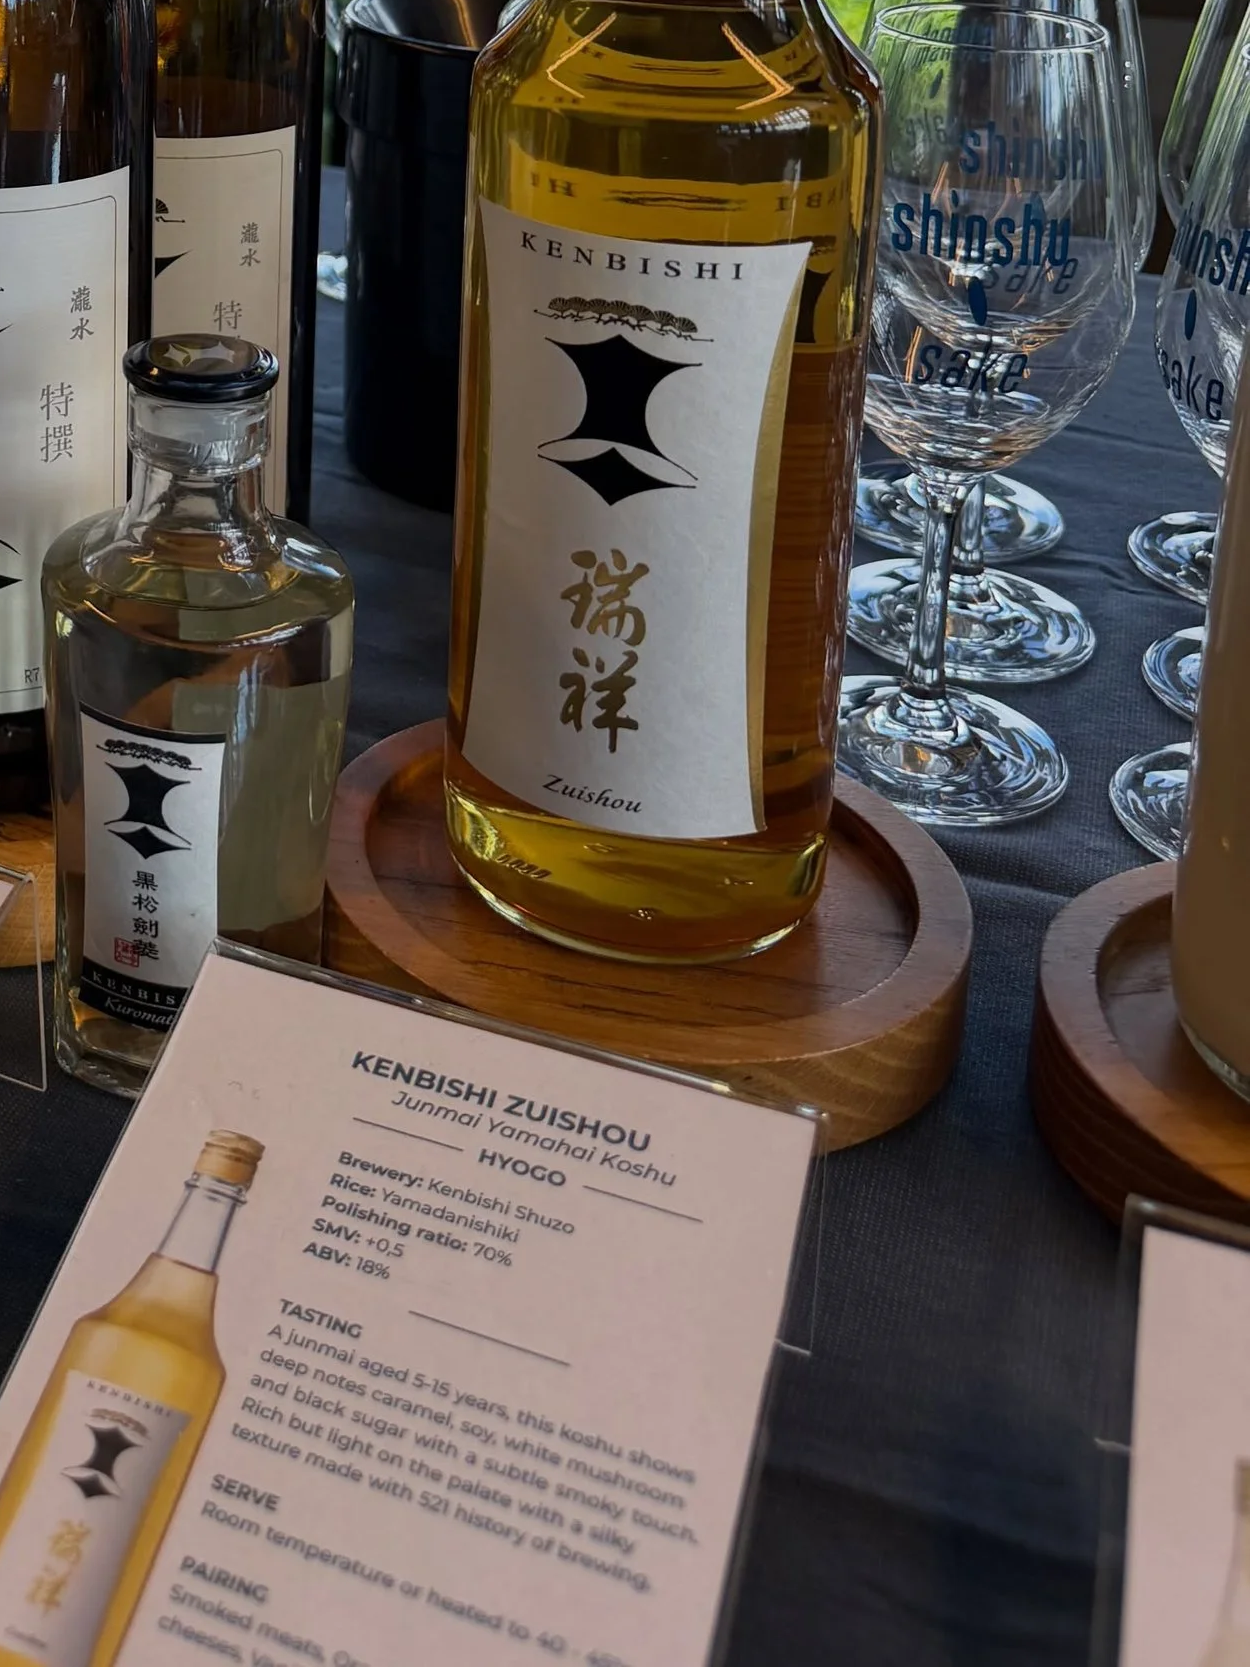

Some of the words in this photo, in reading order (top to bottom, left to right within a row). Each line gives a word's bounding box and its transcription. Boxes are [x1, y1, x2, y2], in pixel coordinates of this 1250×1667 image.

[891, 190, 1072, 268] shinshu
[520, 230, 744, 281] KENBISHI
[914, 343, 1029, 394] sake
[39, 381, 75, 464] 特撰
[542, 774, 644, 815] Zuishou
[93, 970, 177, 1006] KENBIS
[104, 996, 175, 1026] Kuromat
[351, 1050, 498, 1109] KENBISHI
[502, 1094, 651, 1152] ZUISHOU
[390, 1090, 484, 1129] Junmai
[488, 1116, 598, 1163] Yamahai
[599, 1151, 677, 1187] Koshu
[337, 1150, 425, 1189] Brewery:
[427, 1177, 511, 1216] Kenbishi
[514, 1205, 575, 1235] Shuzo
[477, 1148, 567, 1187] HYOGO
[320, 1194, 412, 1238] Polishing
[415, 1227, 468, 1253] ratio:
[473, 1241, 512, 1267] 70%
[329, 1172, 378, 1198] Rice:
[382, 1187, 521, 1243] Yamadanishiki
[302, 1241, 352, 1267] ABV:
[356, 1256, 390, 1280] 18%
[311, 1217, 362, 1245] SMV:
[366, 1237, 405, 1258] +0,5
[280, 1298, 363, 1340] TASTING
[211, 1473, 280, 1513] SERVE
[179, 1555, 269, 1604] PAIRING
